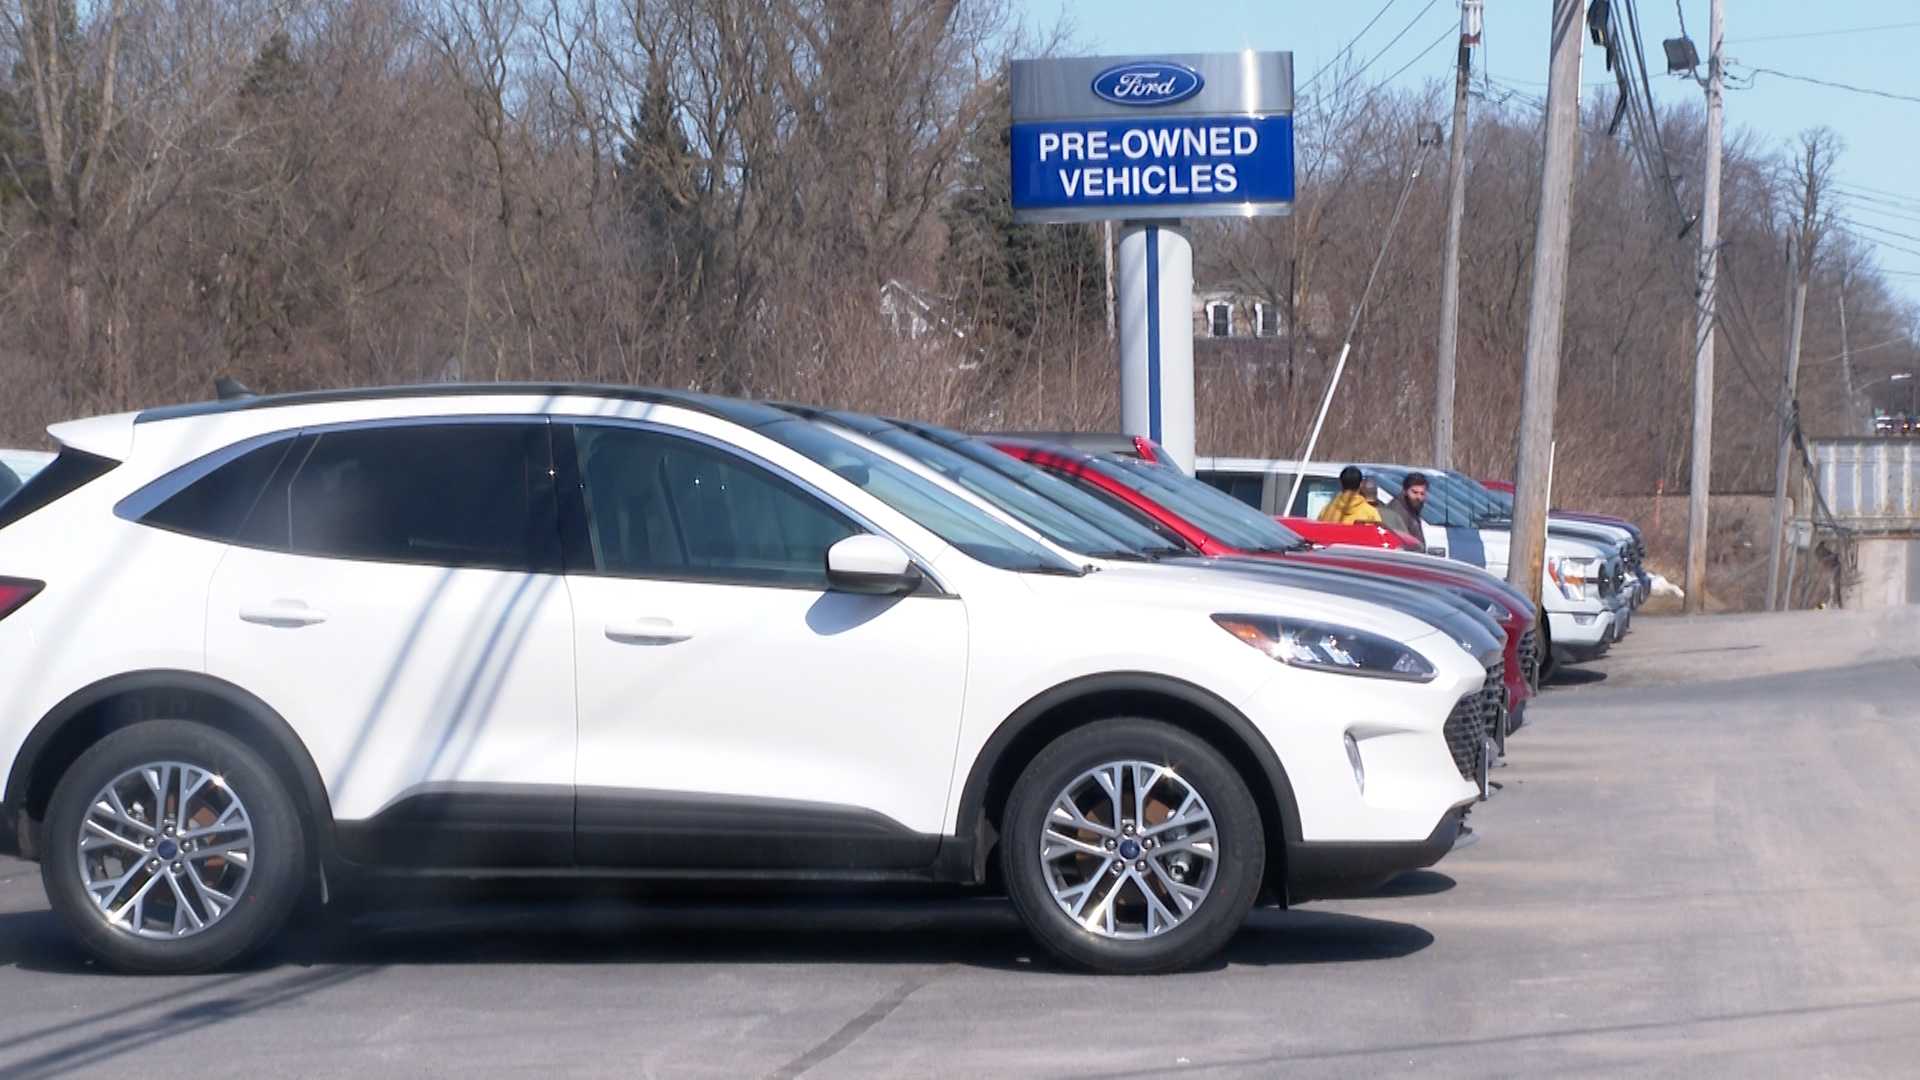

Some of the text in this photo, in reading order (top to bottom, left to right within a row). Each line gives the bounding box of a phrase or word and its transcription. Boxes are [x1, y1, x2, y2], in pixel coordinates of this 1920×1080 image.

[1114, 72, 1176, 97] Ford
[1039, 127, 1258, 161] PRE-OWNED
[1059, 163, 1238, 197] VEHICLES
